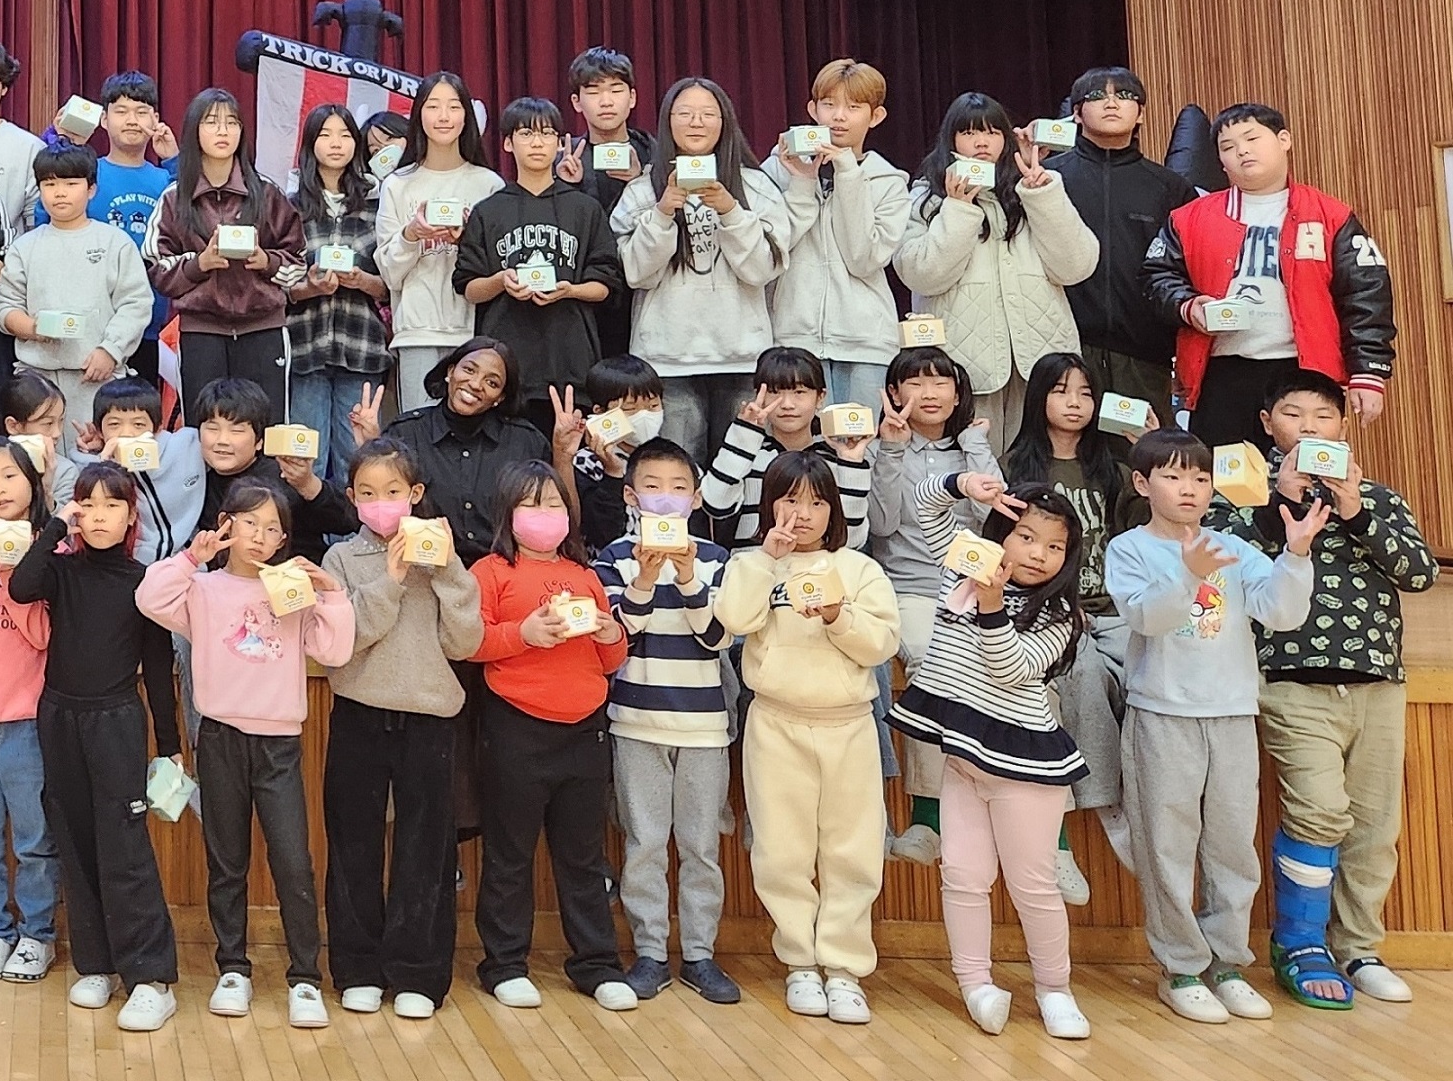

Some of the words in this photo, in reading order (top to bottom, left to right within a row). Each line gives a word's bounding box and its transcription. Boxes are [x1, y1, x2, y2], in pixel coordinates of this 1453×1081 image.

[261, 33, 352, 75] TRICK
[353, 61, 383, 81] OR
[379, 70, 420, 98] TR
